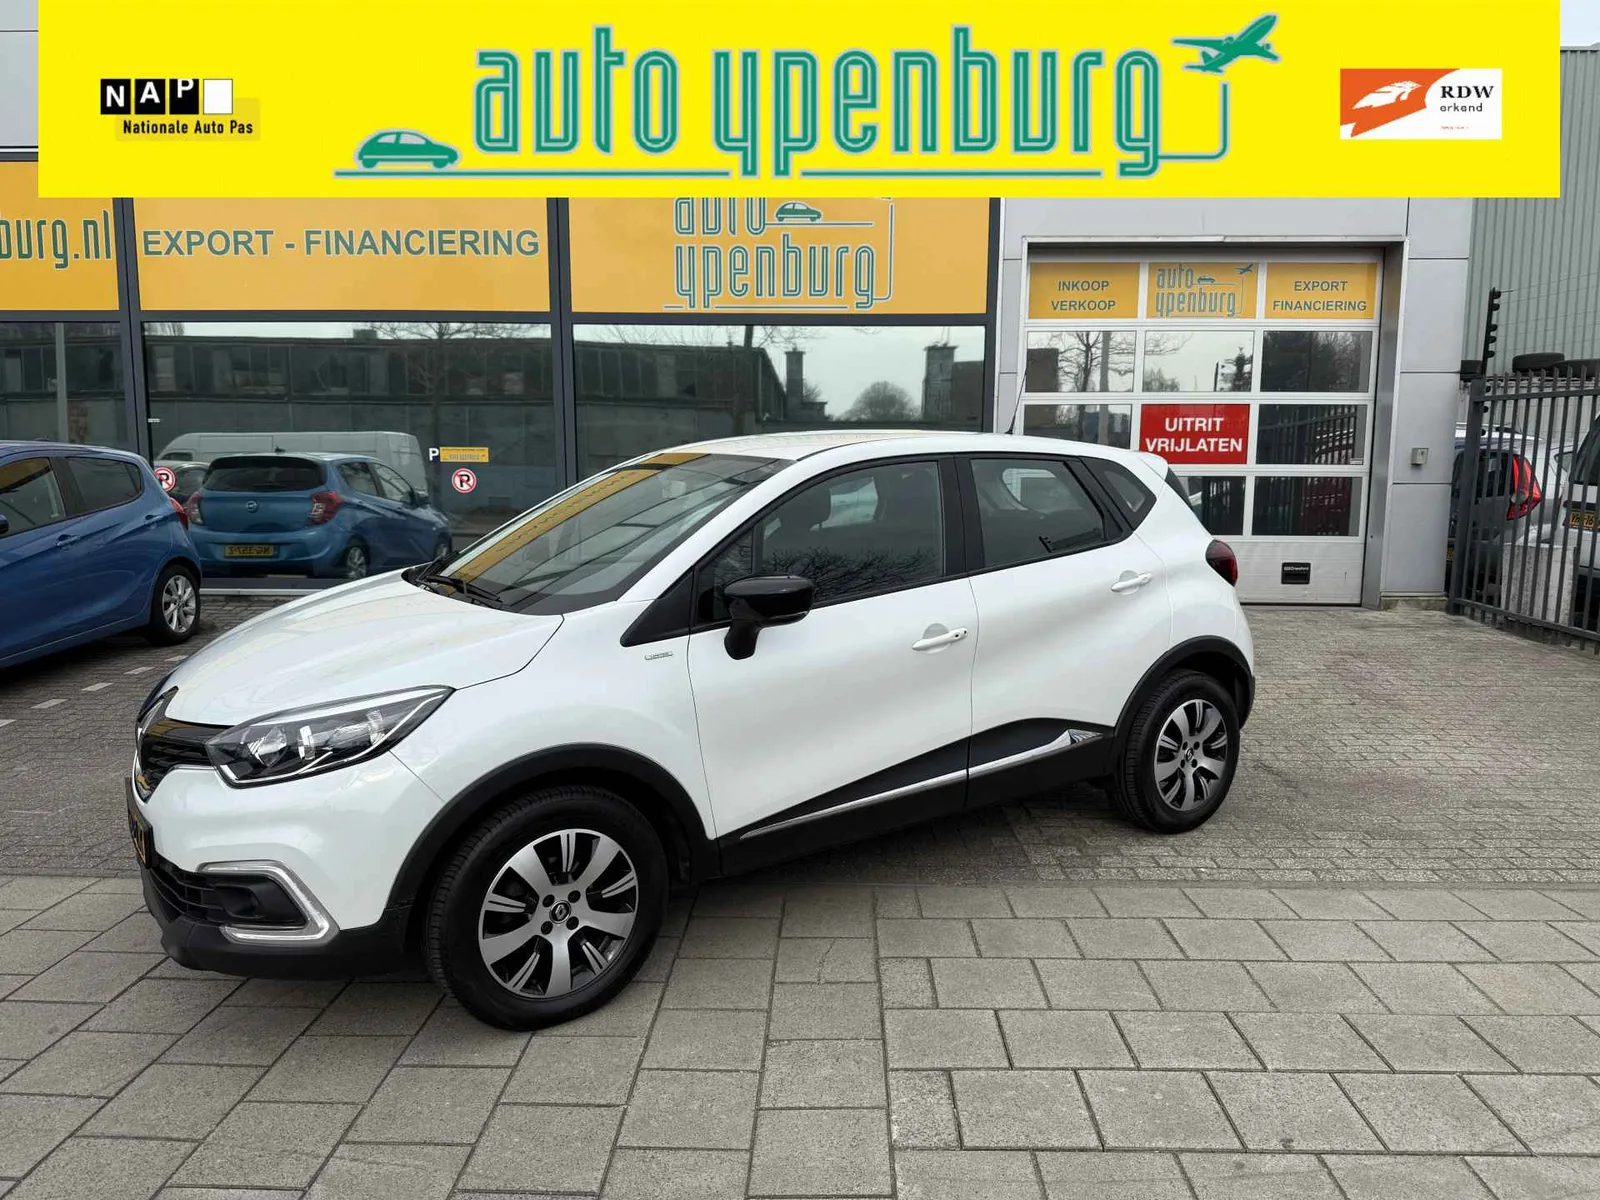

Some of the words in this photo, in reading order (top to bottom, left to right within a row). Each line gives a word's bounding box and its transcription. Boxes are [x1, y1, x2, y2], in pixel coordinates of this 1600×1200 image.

[143, 230, 274, 256] EXPORT
[304, 230, 539, 256] FINANCIERING
[675, 233, 875, 309] ypenburg
[1156, 265, 1194, 288] auto
[1058, 280, 1109, 292] INKOOP
[1294, 280, 1348, 292] EXPORT
[1051, 299, 1116, 312] VERKOOP
[1155, 287, 1237, 317] ypenburg
[1272, 300, 1367, 312] FINANCIERING
[1165, 417, 1225, 432] UITRIT
[1145, 437, 1243, 453] VRIJLATEN
[428, 447, 440, 461] P
